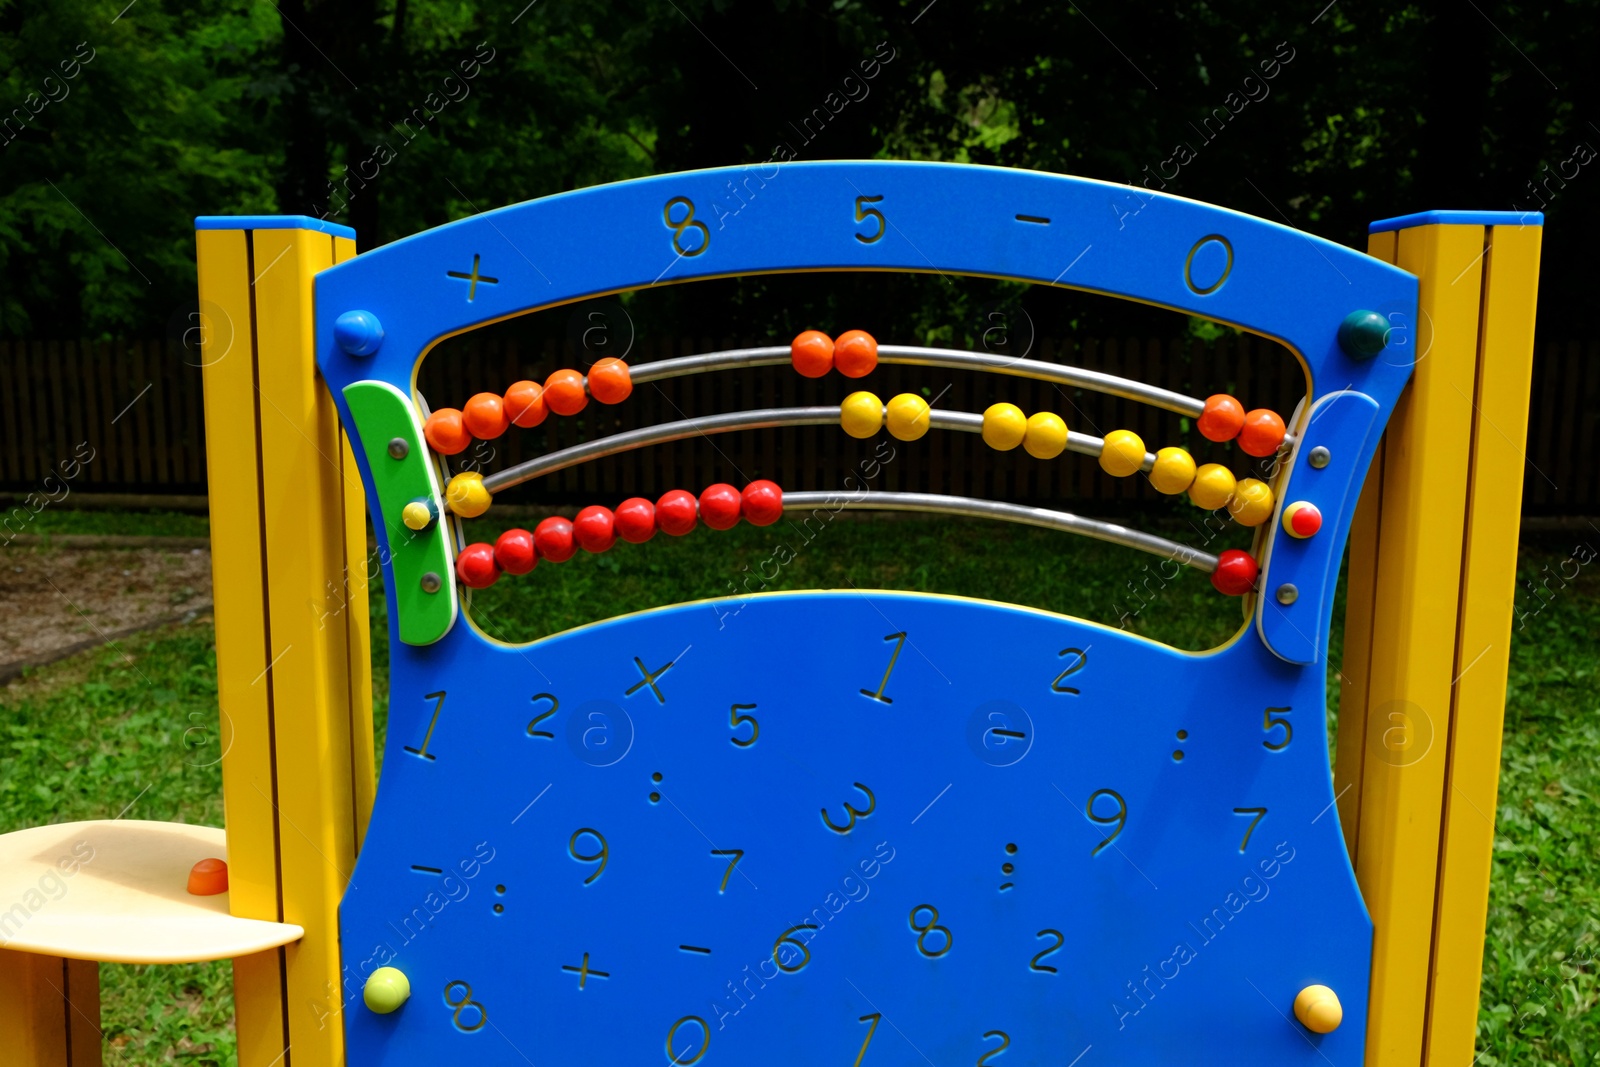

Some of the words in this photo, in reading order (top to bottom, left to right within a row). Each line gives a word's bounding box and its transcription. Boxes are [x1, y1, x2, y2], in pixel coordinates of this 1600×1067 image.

[664, 196, 710, 257] 8
[855, 195, 886, 243] 5
[1184, 234, 1235, 295] 0
[859, 632, 908, 704] 1
[1051, 648, 1088, 695] 2
[403, 691, 447, 761] 1
[526, 693, 560, 739] 2
[730, 703, 760, 747] 5
[1262, 706, 1293, 751] 5
[1085, 788, 1128, 857] 9
[1232, 806, 1268, 854] 7
[569, 828, 609, 885] 9
[710, 849, 745, 893] 7
[773, 923, 819, 973] 6
[909, 904, 953, 958] 8
[1029, 929, 1065, 974] 2
[443, 980, 488, 1032] 8
[666, 1014, 711, 1066] 0
